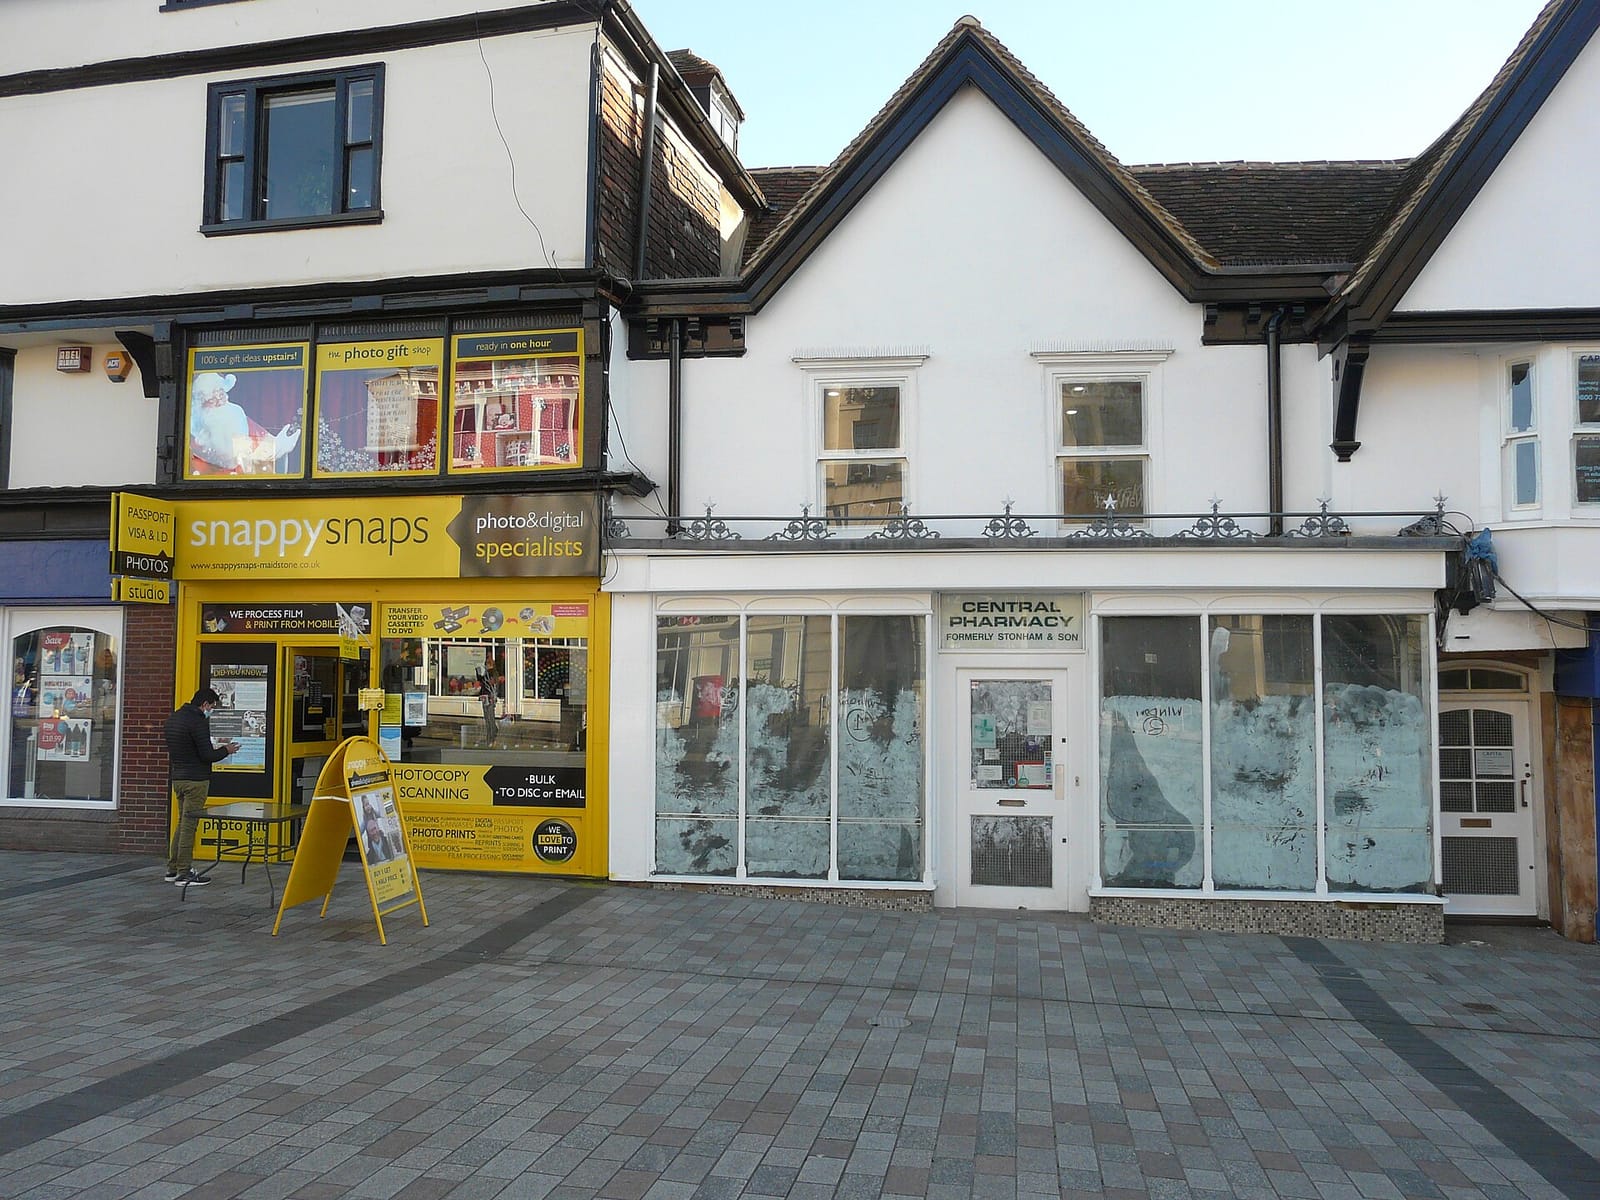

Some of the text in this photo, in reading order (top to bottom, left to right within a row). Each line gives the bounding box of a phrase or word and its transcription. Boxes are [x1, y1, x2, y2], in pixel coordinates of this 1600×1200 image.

[476, 341, 498, 352] ready
[202, 352, 298, 365] 100's of gift ideas upstairs!
[344, 346, 384, 363] photo
[386, 345, 409, 360] gift
[412, 346, 431, 356] shop
[128, 506, 170, 524] PASSPORT
[476, 510, 584, 534] photo&digital
[128, 526, 146, 540] VISA
[148, 530, 154, 540] &
[190, 516, 429, 557] snappysnaps
[476, 535, 583, 563] specialists
[126, 556, 169, 573] PHOTOS
[190, 560, 321, 571] www.snappysnaps-maidstone.co.uk
[129, 584, 164, 600] studio
[962, 602, 1061, 613] CENTRAL
[229, 610, 303, 619] WE PROCESS FILM
[246, 621, 251, 629] &
[254, 620, 279, 629] PRINT
[281, 620, 305, 629] FROM
[950, 616, 1074, 627] PHARMACY
[1058, 633, 1078, 641] SON
[400, 787, 469, 800] SCANNING
[518, 788, 540, 798] DISC
[555, 789, 584, 799] EMAIL
[204, 818, 242, 833] photo
[494, 825, 524, 833] PHOTOS
[412, 828, 476, 839] PHOTO PRINTS
[413, 844, 460, 852] PHOTOBOOKS
